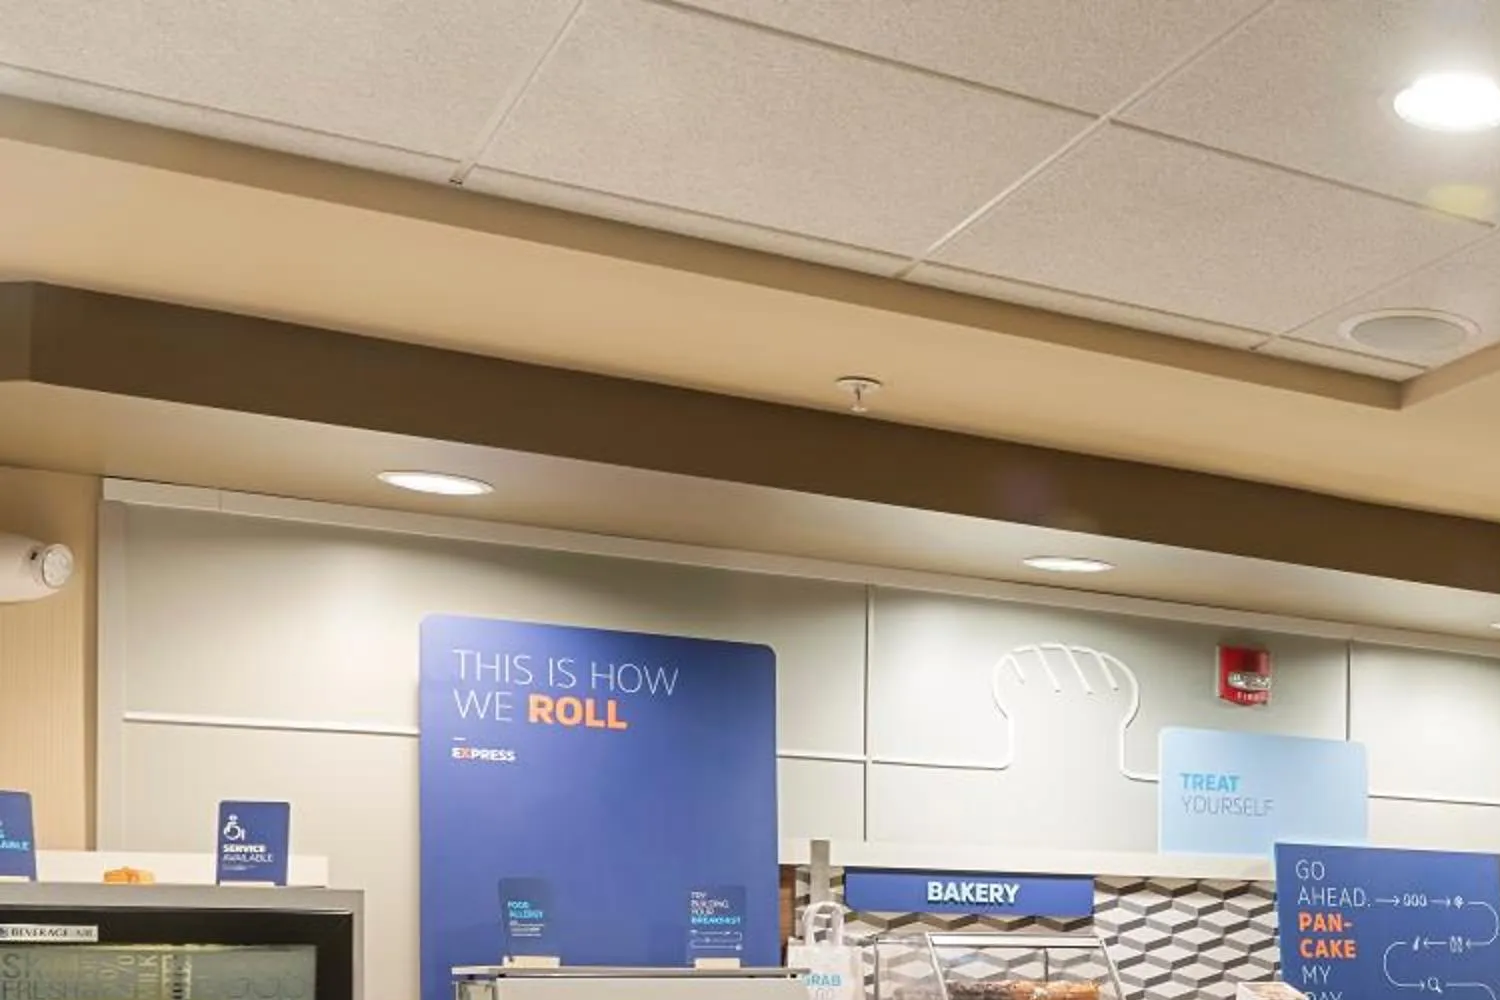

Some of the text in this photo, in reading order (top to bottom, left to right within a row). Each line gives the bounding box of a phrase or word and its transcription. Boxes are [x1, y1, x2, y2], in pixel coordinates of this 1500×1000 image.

[453, 649, 679, 697] THIS IS HOW
[453, 689, 628, 730] WE ROLL
[452, 748, 516, 761] EXPRESS
[1181, 773, 1240, 792] TREAT
[1181, 795, 1275, 817] YOURSELF
[222, 853, 274, 863] AVAILABLE
[223, 844, 266, 854] SERVICE
[1295, 859, 1325, 881] GO
[927, 881, 1020, 904] BAKERY
[1297, 886, 1371, 908] AHEAD.
[11, 927, 69, 938] BEVERAGE
[1297, 911, 1353, 933] PAN-
[1299, 938, 1357, 959] CAKE
[1301, 964, 1331, 985] MY
